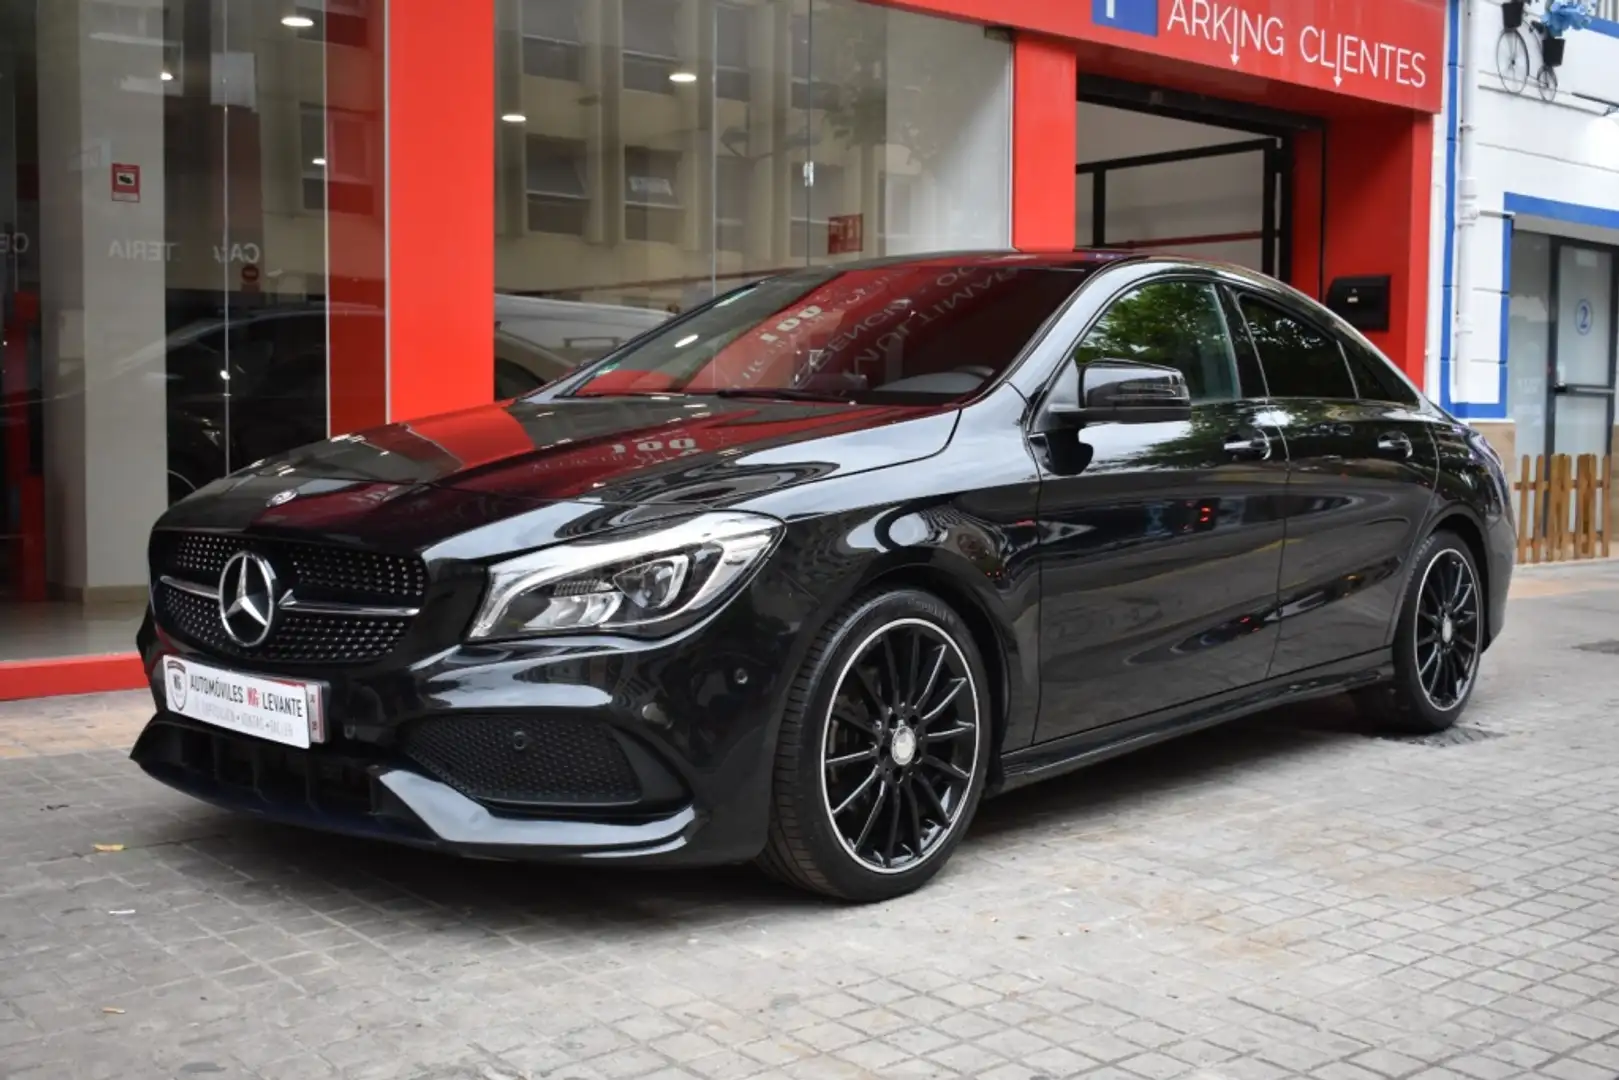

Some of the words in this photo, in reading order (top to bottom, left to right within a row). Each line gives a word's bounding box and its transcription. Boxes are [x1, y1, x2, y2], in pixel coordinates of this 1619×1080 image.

[1299, 25, 1427, 88] CLIENTES
[1579, 305, 1589, 329] 2
[190, 675, 244, 704] AUTOMÓVILES
[261, 691, 304, 719] LEVANTE
